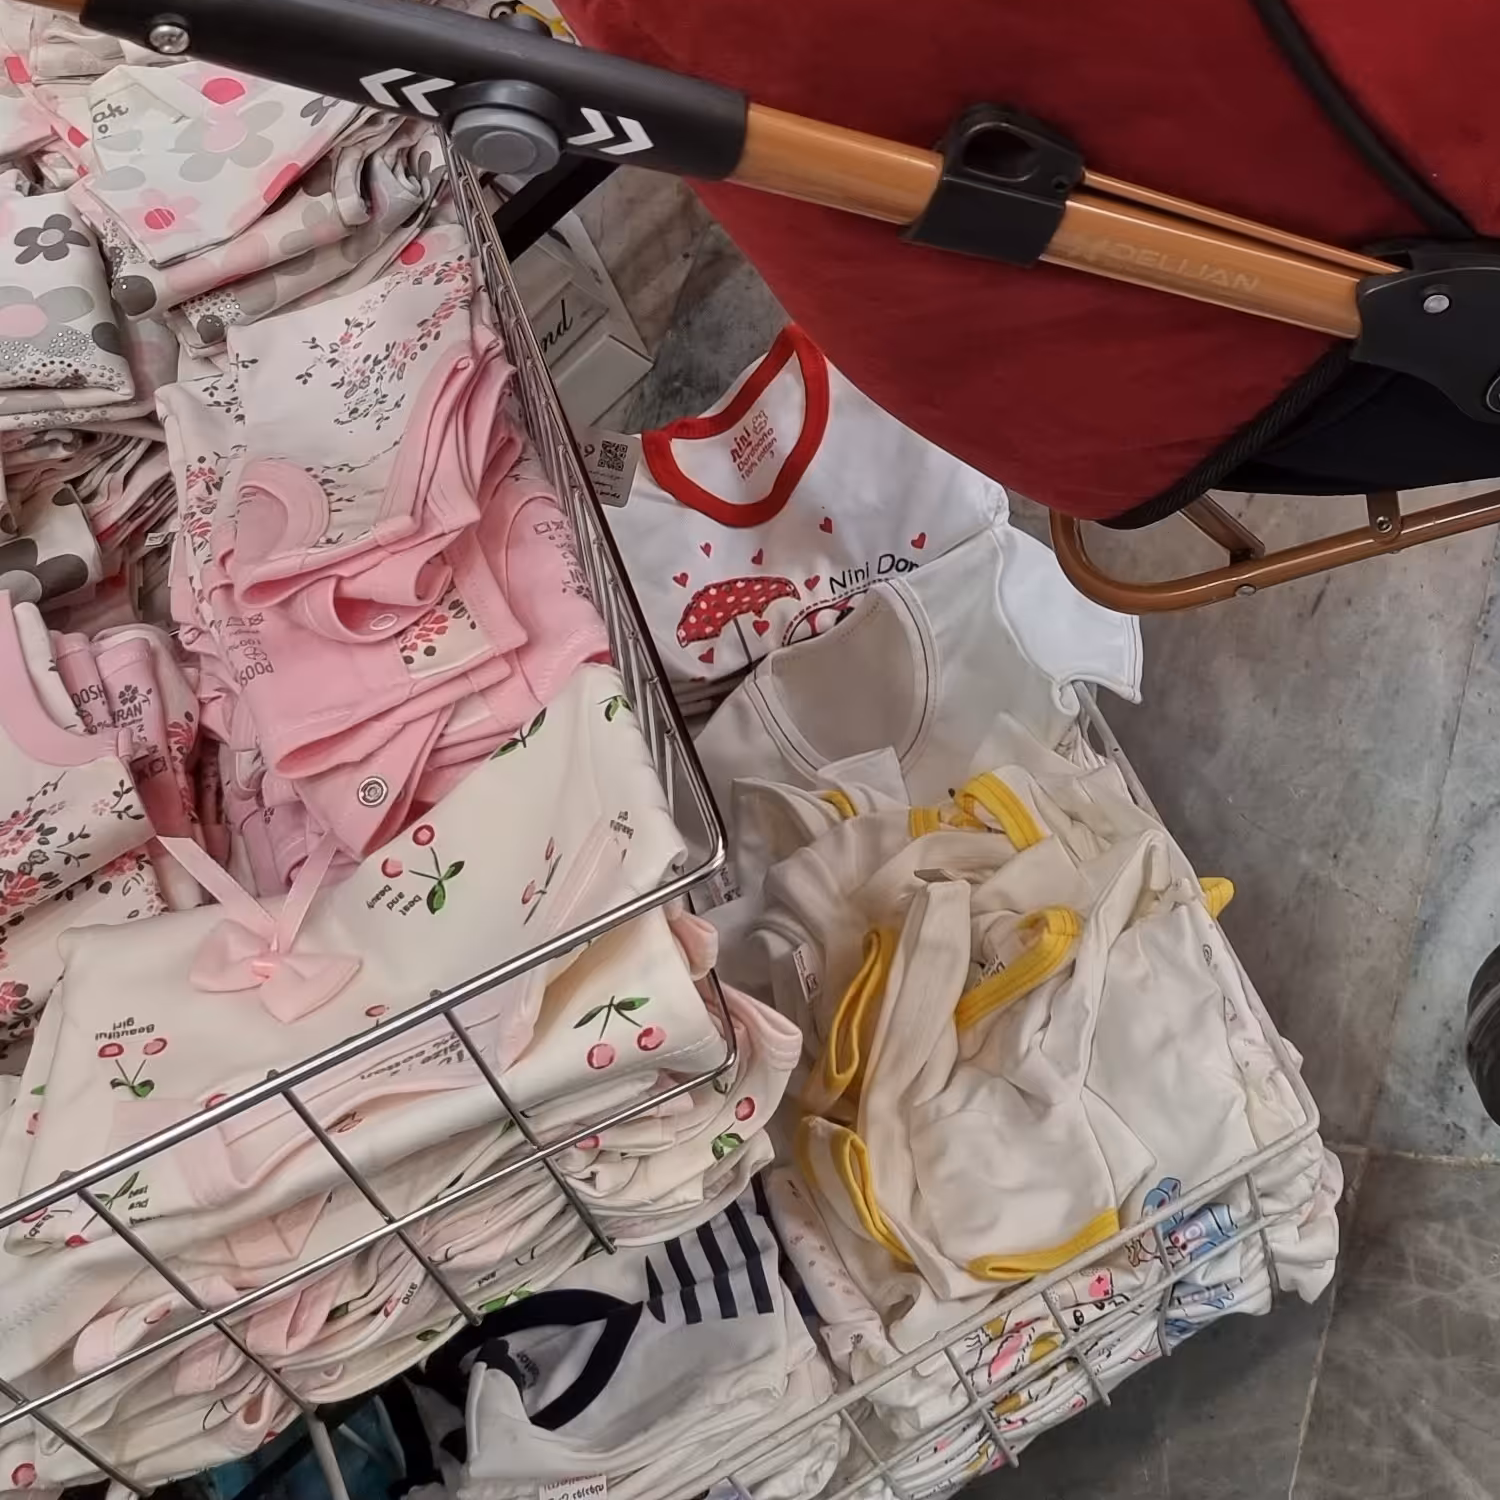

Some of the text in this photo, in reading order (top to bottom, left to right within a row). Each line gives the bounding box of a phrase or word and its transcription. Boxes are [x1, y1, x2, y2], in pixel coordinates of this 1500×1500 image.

[829, 553, 920, 595] Nini Dor
[386, 891, 405, 911] and
[95, 1023, 155, 1041] Beautiful
[112, 1016, 135, 1031] girl
